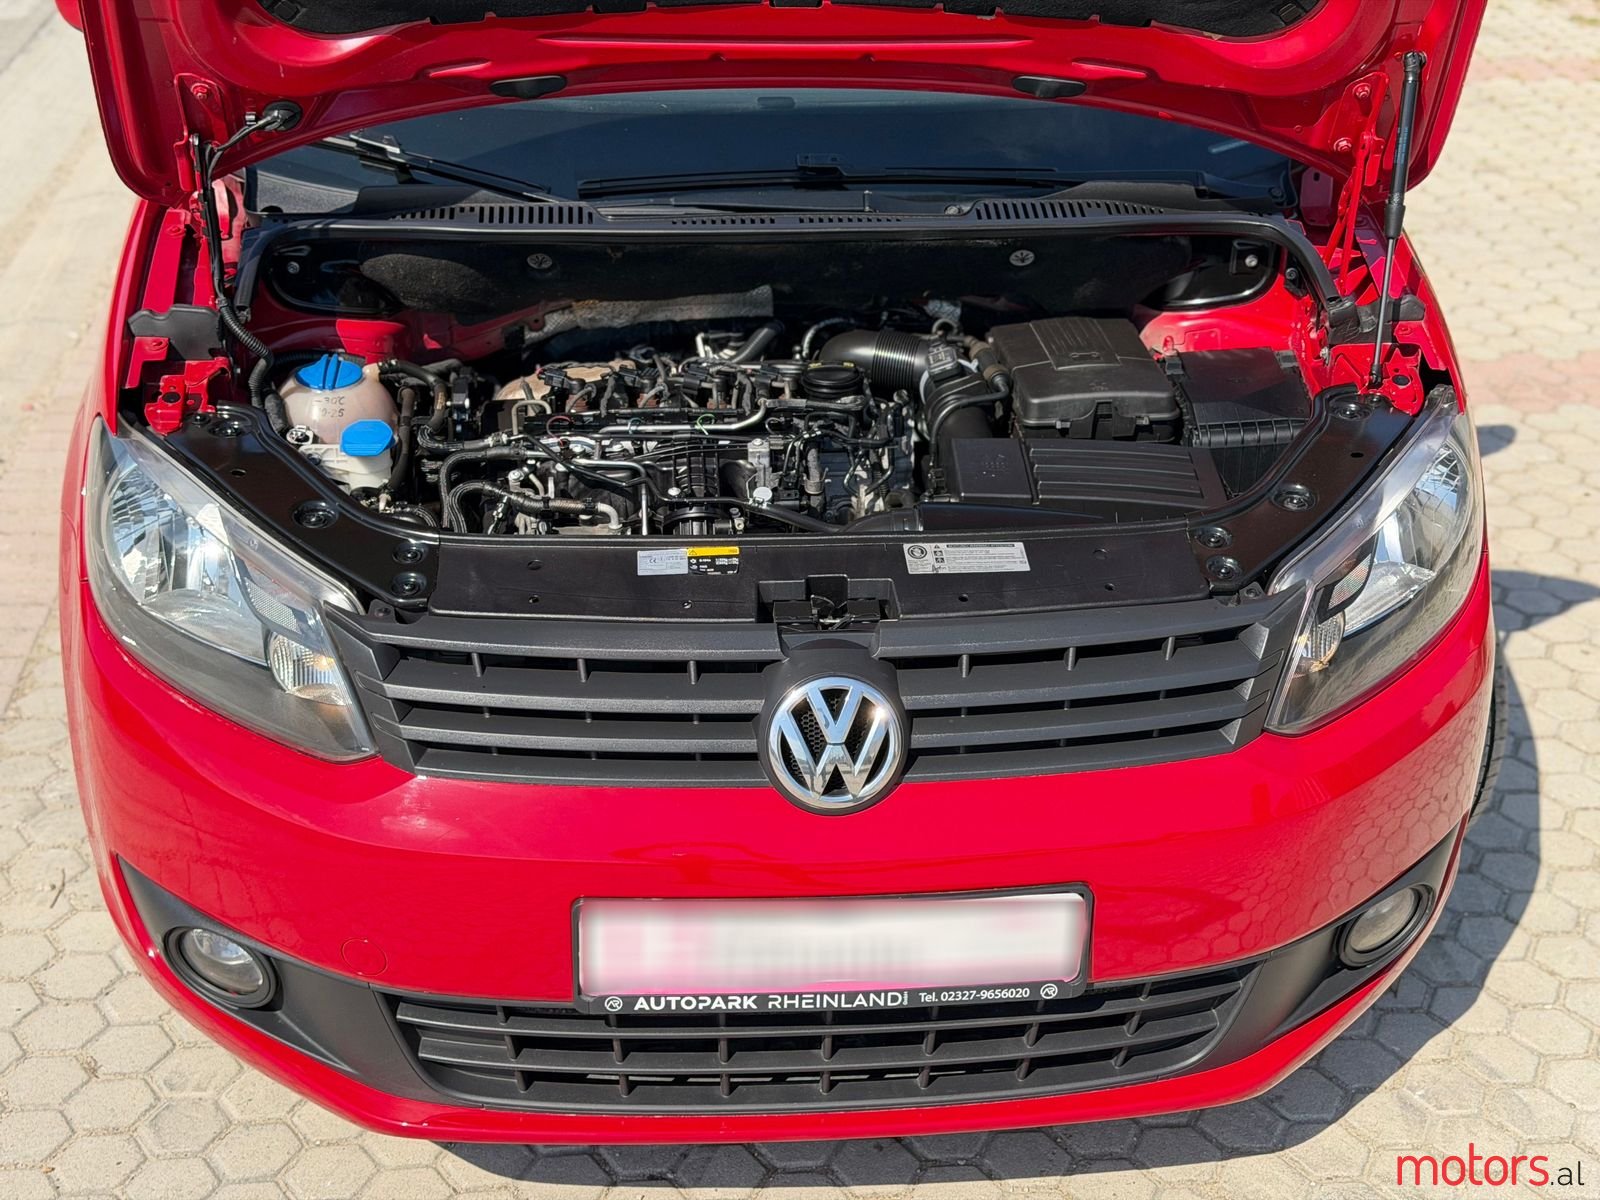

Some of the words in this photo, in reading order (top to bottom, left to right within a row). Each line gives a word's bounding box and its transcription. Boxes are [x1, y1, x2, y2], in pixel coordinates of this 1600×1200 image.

[770, 679, 901, 807] VW
[633, 995, 758, 1011] AUTOPARK
[768, 992, 902, 1009] RHEINLAND
[918, 991, 939, 1002] Tel.
[940, 988, 1030, 1002] 02327-9656020
